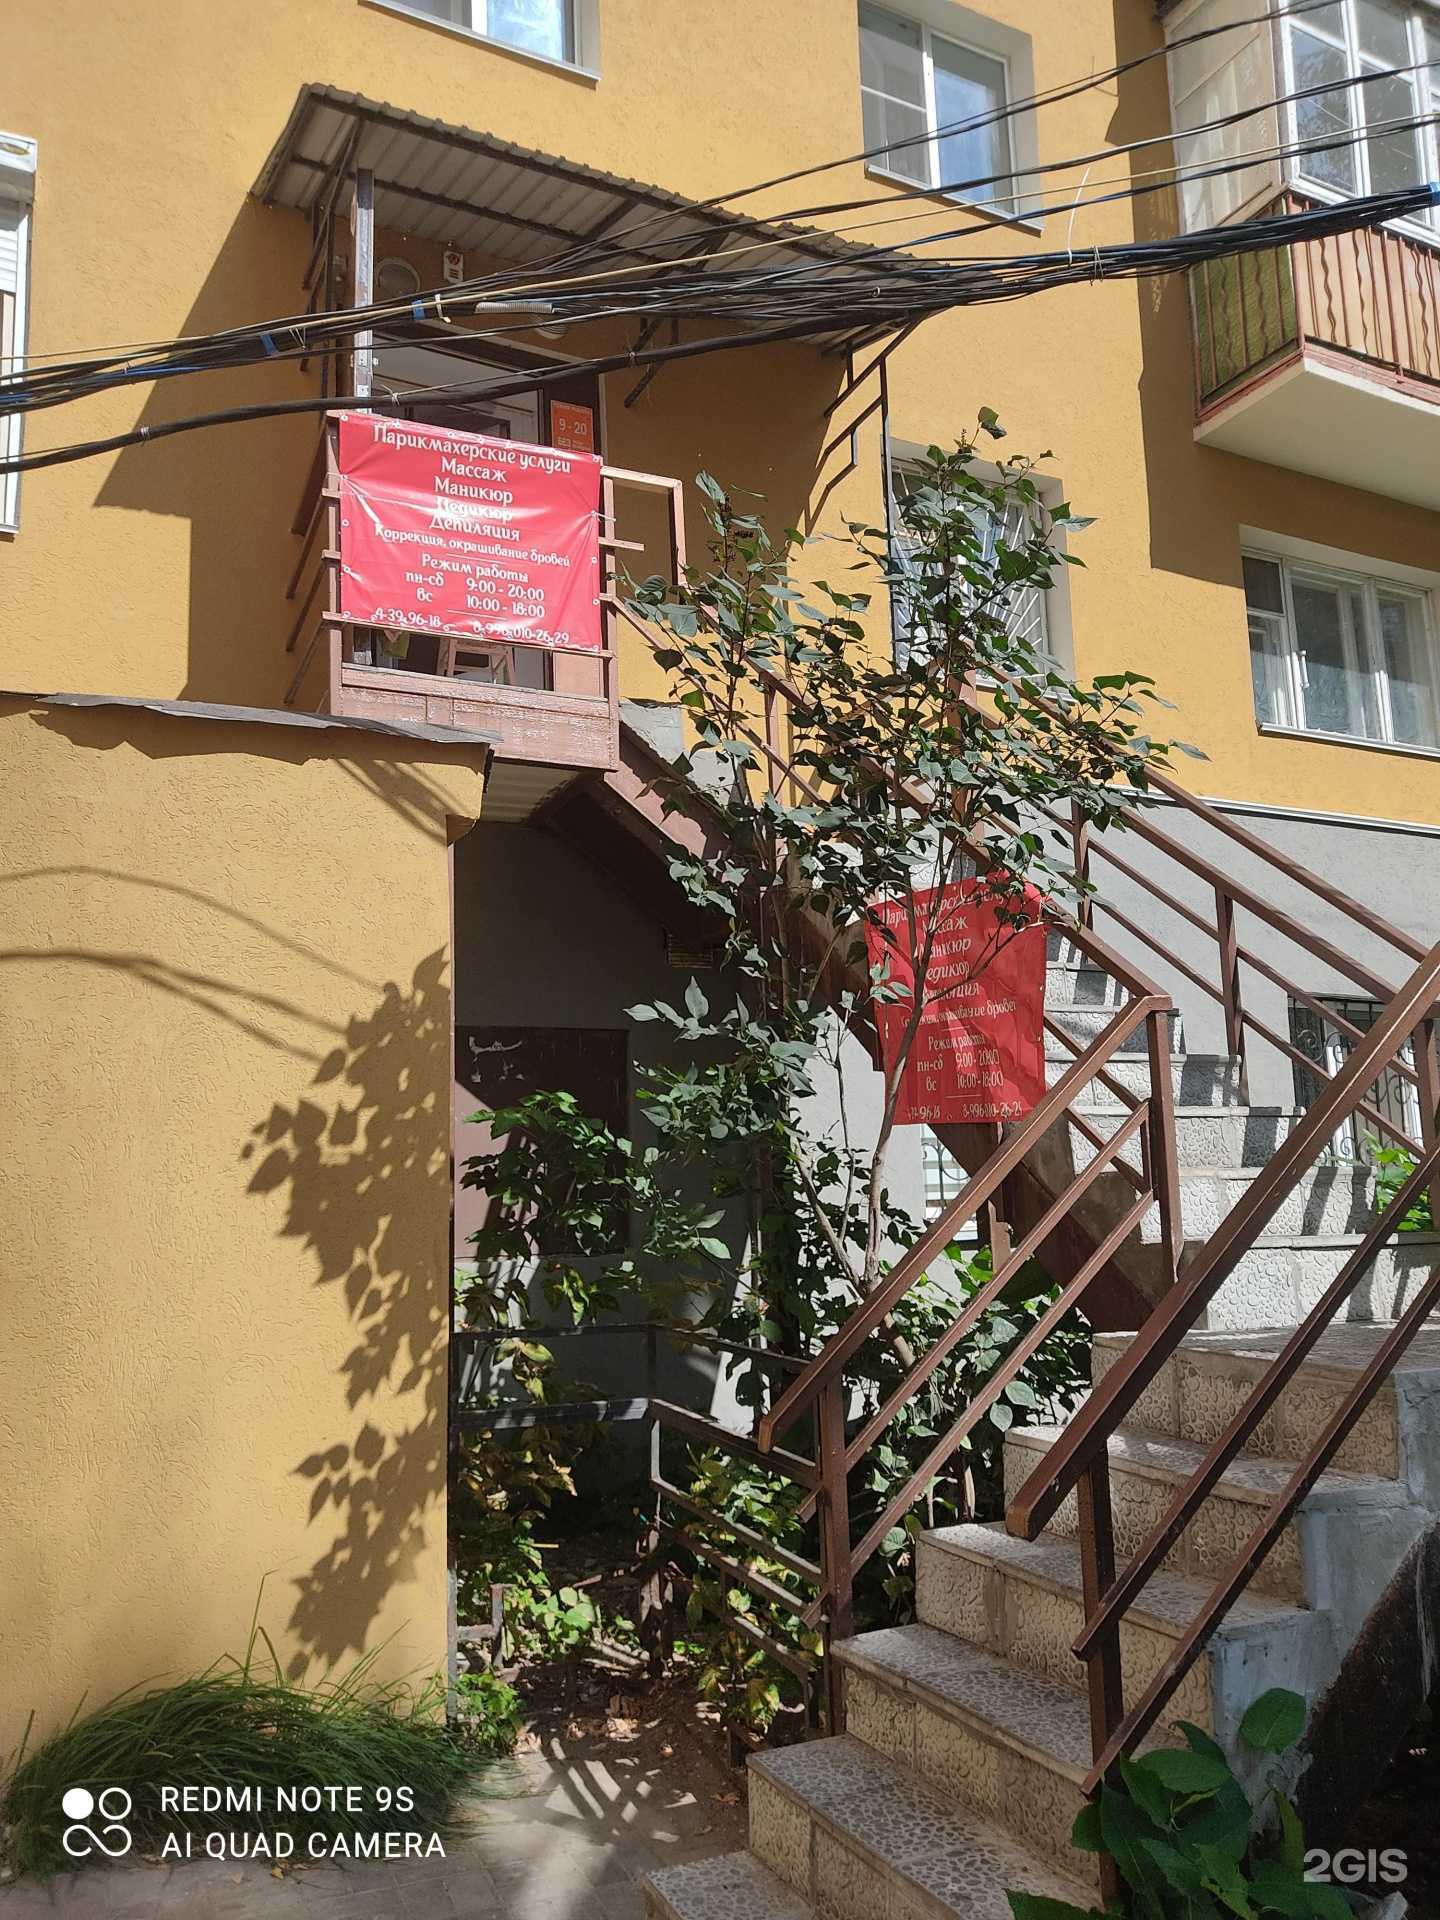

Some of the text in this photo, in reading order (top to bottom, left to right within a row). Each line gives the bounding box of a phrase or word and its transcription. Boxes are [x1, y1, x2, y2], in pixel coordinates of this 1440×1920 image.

[560, 418, 566, 432] 9
[574, 421, 587, 435] 20
[374, 423, 571, 474] Парикмахерские услуги
[441, 457, 507, 482] Массаж
[434, 476, 513, 507] Маникюр
[436, 495, 513, 525] Педикюр
[429, 514, 520, 541] Депиляция
[449, 540, 528, 561] окрашивание
[530, 549, 571, 567] бровей
[421, 553, 529, 584] Режим работы
[405, 571, 445, 588] пн-сб
[466, 577, 496, 595] 9:00
[507, 584, 545, 602] 20:00
[416, 587, 433, 602] вс
[466, 595, 500, 613] 10:00
[512, 600, 545, 618] 18:00
[922, 961, 970, 984] едикюр
[916, 1054, 943, 1072] пн-сб
[926, 1076, 937, 1091] вс
